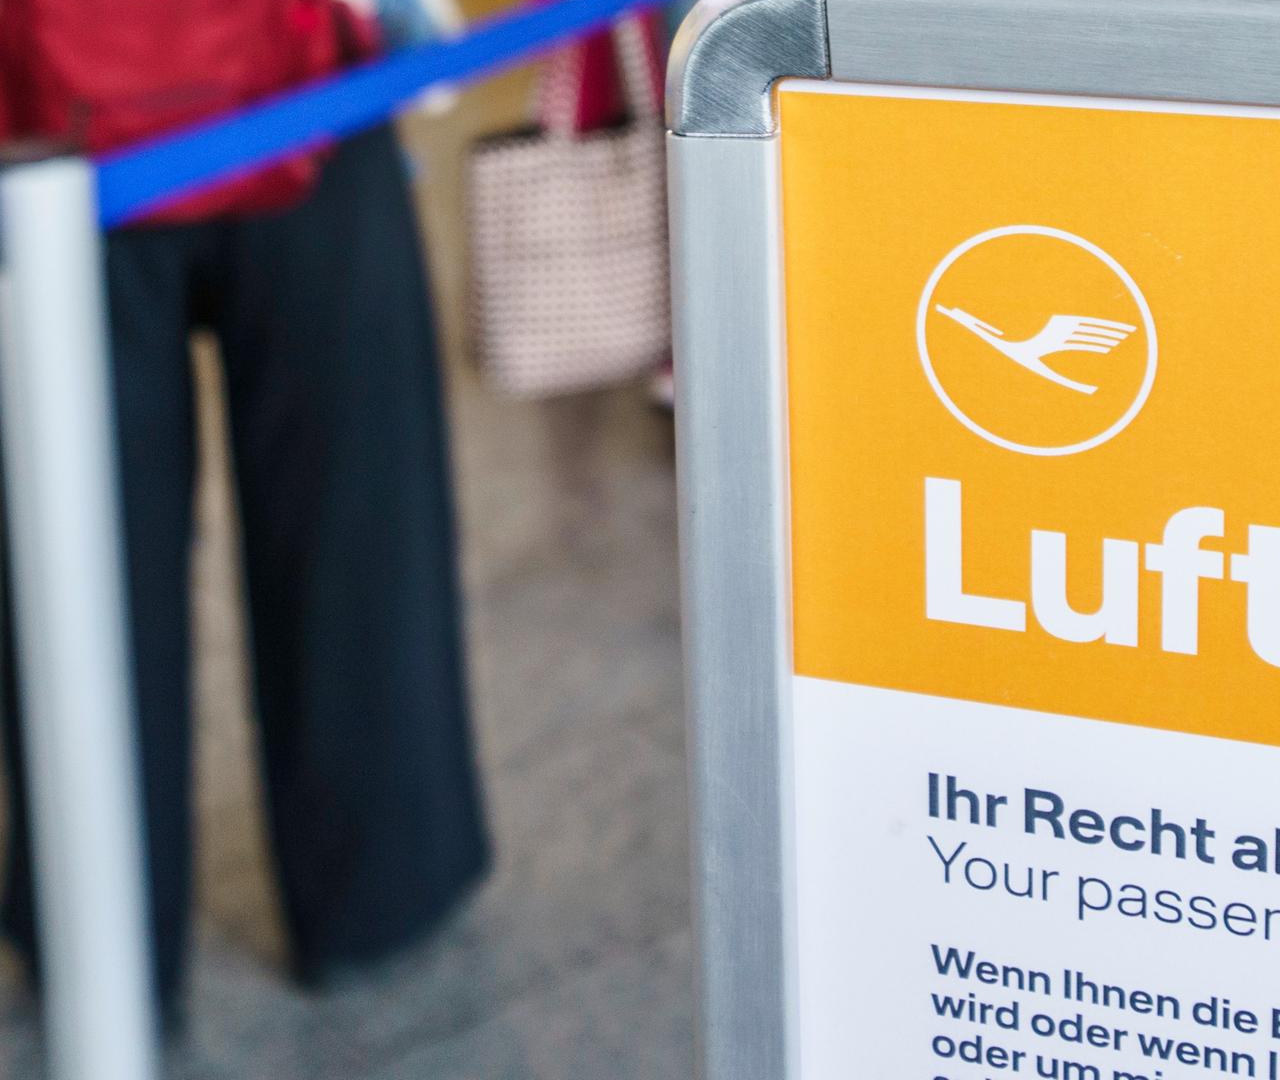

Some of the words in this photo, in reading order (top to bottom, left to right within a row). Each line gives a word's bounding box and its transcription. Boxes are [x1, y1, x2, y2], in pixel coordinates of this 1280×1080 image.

[928, 772, 1009, 828] Ihr
[1024, 787, 1217, 865] Recht
[926, 835, 1060, 901] Your
[930, 943, 1052, 996] Wenn
[1063, 968, 1181, 1020] Ihnen
[1192, 995, 1259, 1035] die
[930, 992, 1020, 1032] wird
[1030, 1013, 1130, 1052] oder
[1137, 1033, 1257, 1078] wenn
[930, 1034, 1028, 1072] oder
[1036, 1055, 1102, 1080] um
